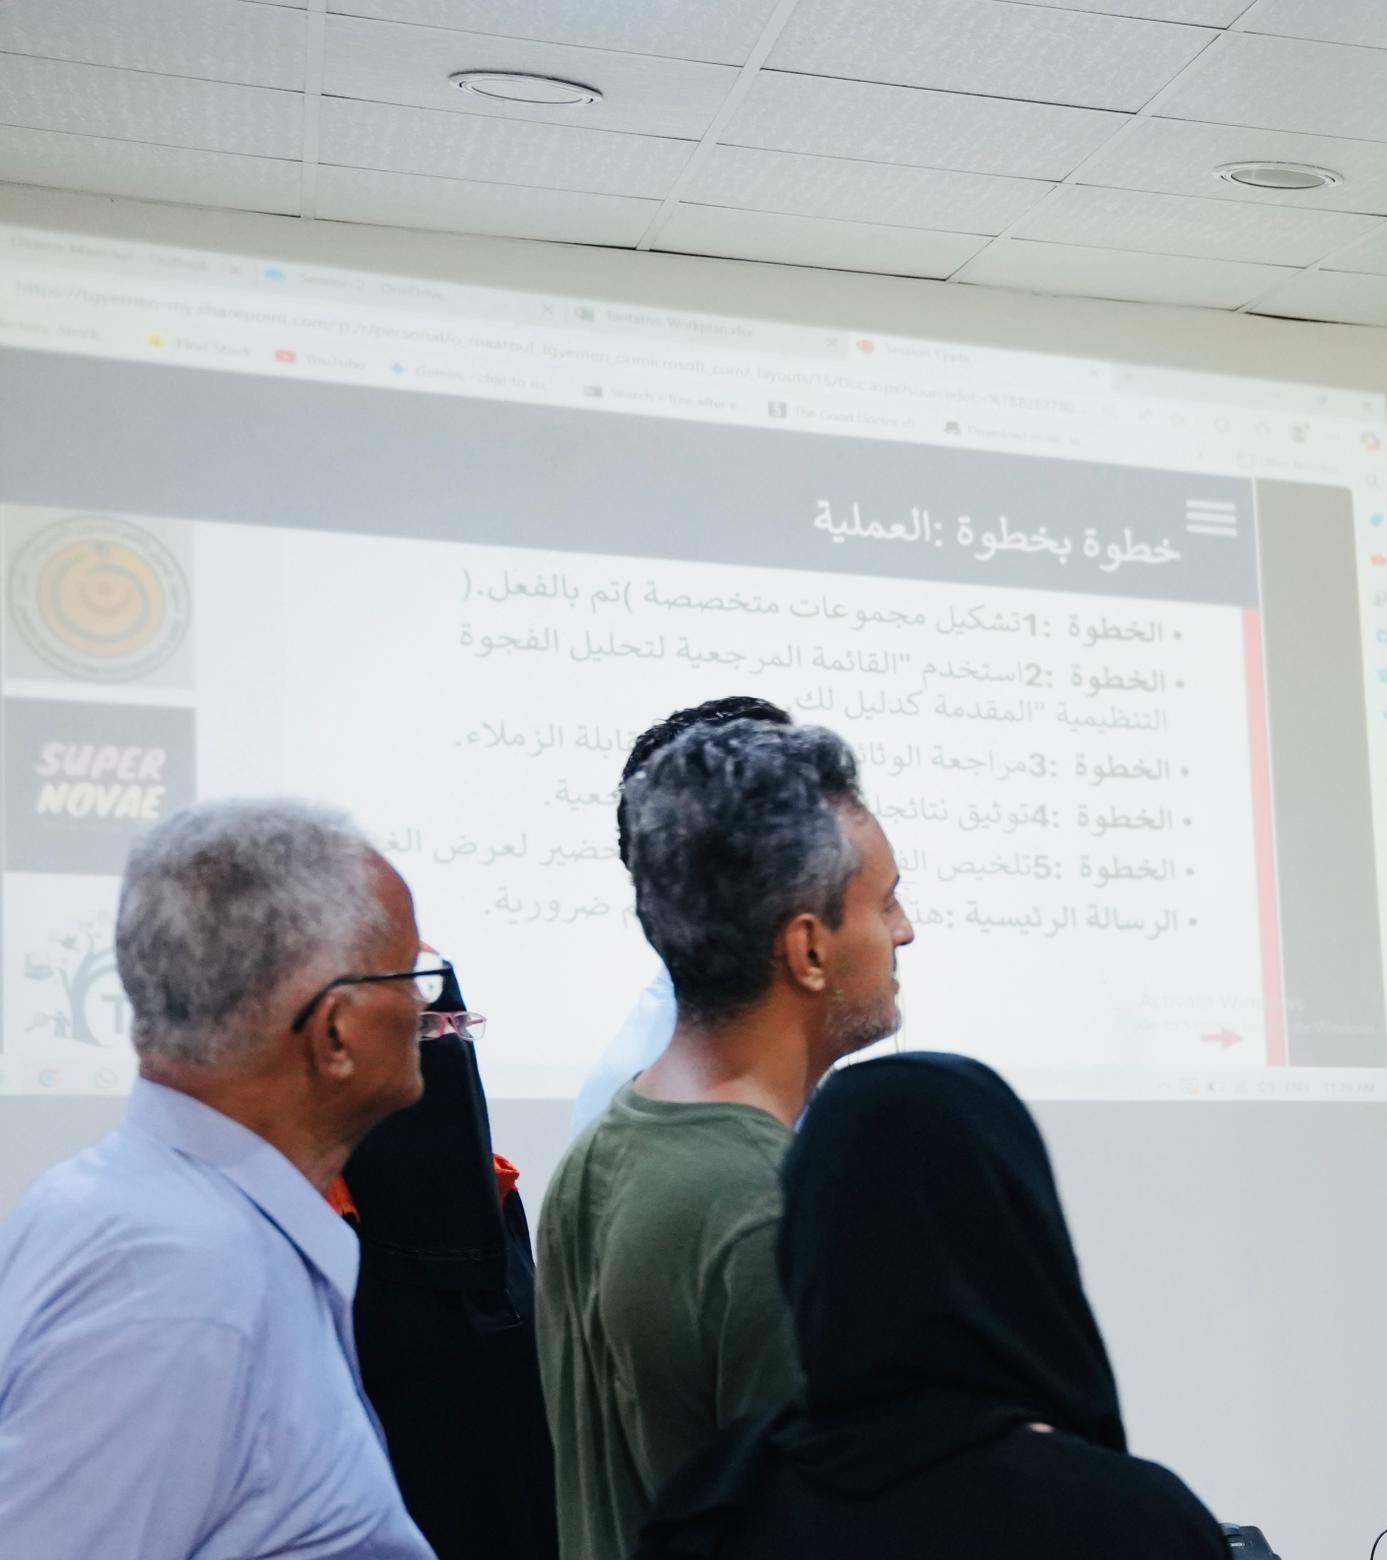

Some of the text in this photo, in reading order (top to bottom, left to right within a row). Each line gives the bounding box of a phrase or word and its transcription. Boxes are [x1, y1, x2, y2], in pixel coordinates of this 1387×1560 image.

[957, 514, 1072, 566] بخطوة
[1083, 527, 1182, 573] خطوة
[643, 580, 779, 615] متخصصة
[789, 596, 926, 631] مجموعات
[459, 623, 559, 659] الفجوة
[570, 629, 664, 662] لتحليل
[844, 689, 923, 720] كدليل
[35, 741, 167, 781] SUPER
[36, 781, 167, 820] NOVAE
[965, 902, 1077, 938] الرئيسية
[1086, 904, 1179, 940] الرسالة
